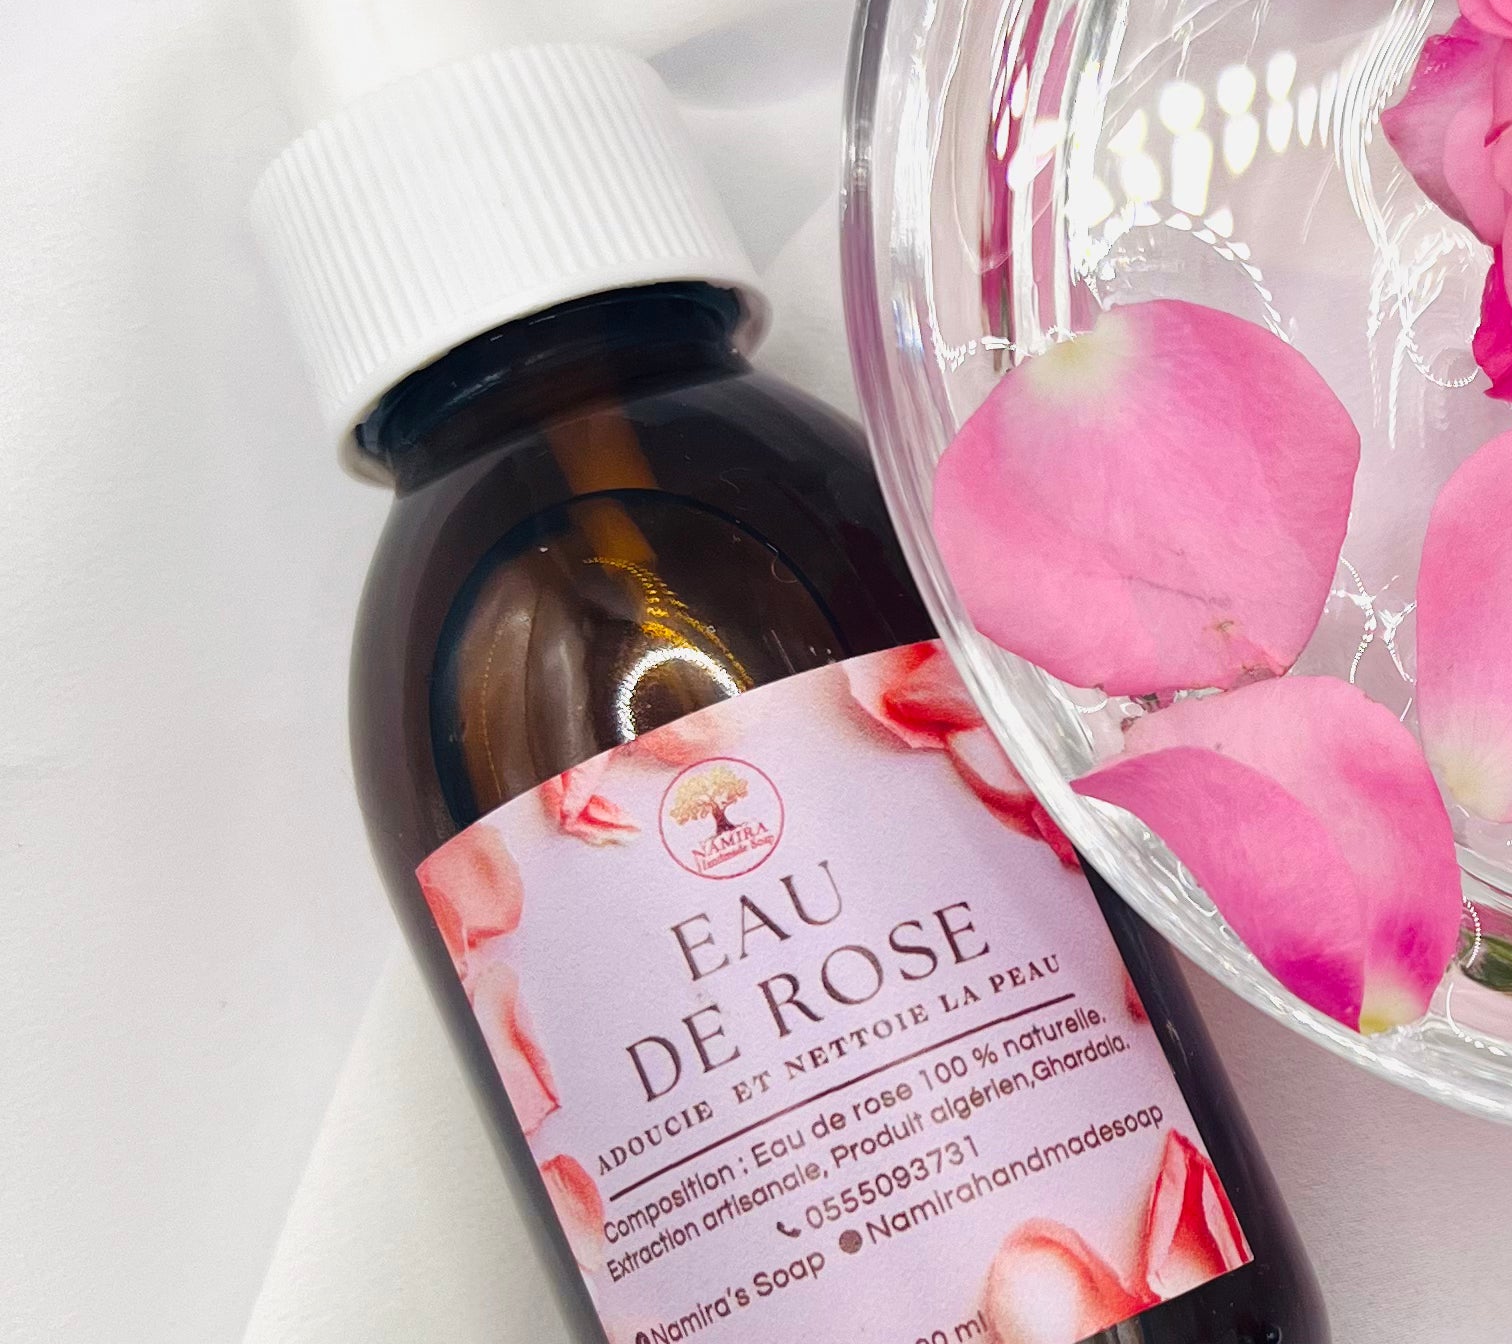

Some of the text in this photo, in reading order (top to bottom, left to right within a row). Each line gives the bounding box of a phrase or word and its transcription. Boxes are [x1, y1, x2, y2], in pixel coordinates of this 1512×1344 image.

[671, 860, 842, 981] EAU
[692, 822, 768, 864] NAMIRA
[598, 954, 1060, 1176] ADOUCIE ET NETTOIE LA PEAU
[626, 902, 989, 1102] DE ROSE
[603, 1163, 735, 1244] Composition
[751, 1130, 806, 1167] Eau
[811, 1112, 846, 1138] de
[852, 1083, 912, 1121] rose
[918, 1055, 968, 1091] 100
[972, 1043, 998, 1068] %
[1002, 1007, 1106, 1058] naturelle.
[607, 1221, 700, 1283] Extraction
[702, 1162, 829, 1231] artisanale,
[830, 1111, 924, 1168] Produit
[753, 1252, 825, 1297] Soap
[866, 1105, 1163, 1244] Namirahandmadesoap
[805, 1135, 979, 1230] 0555093731
[954, 1309, 988, 1343] ml
